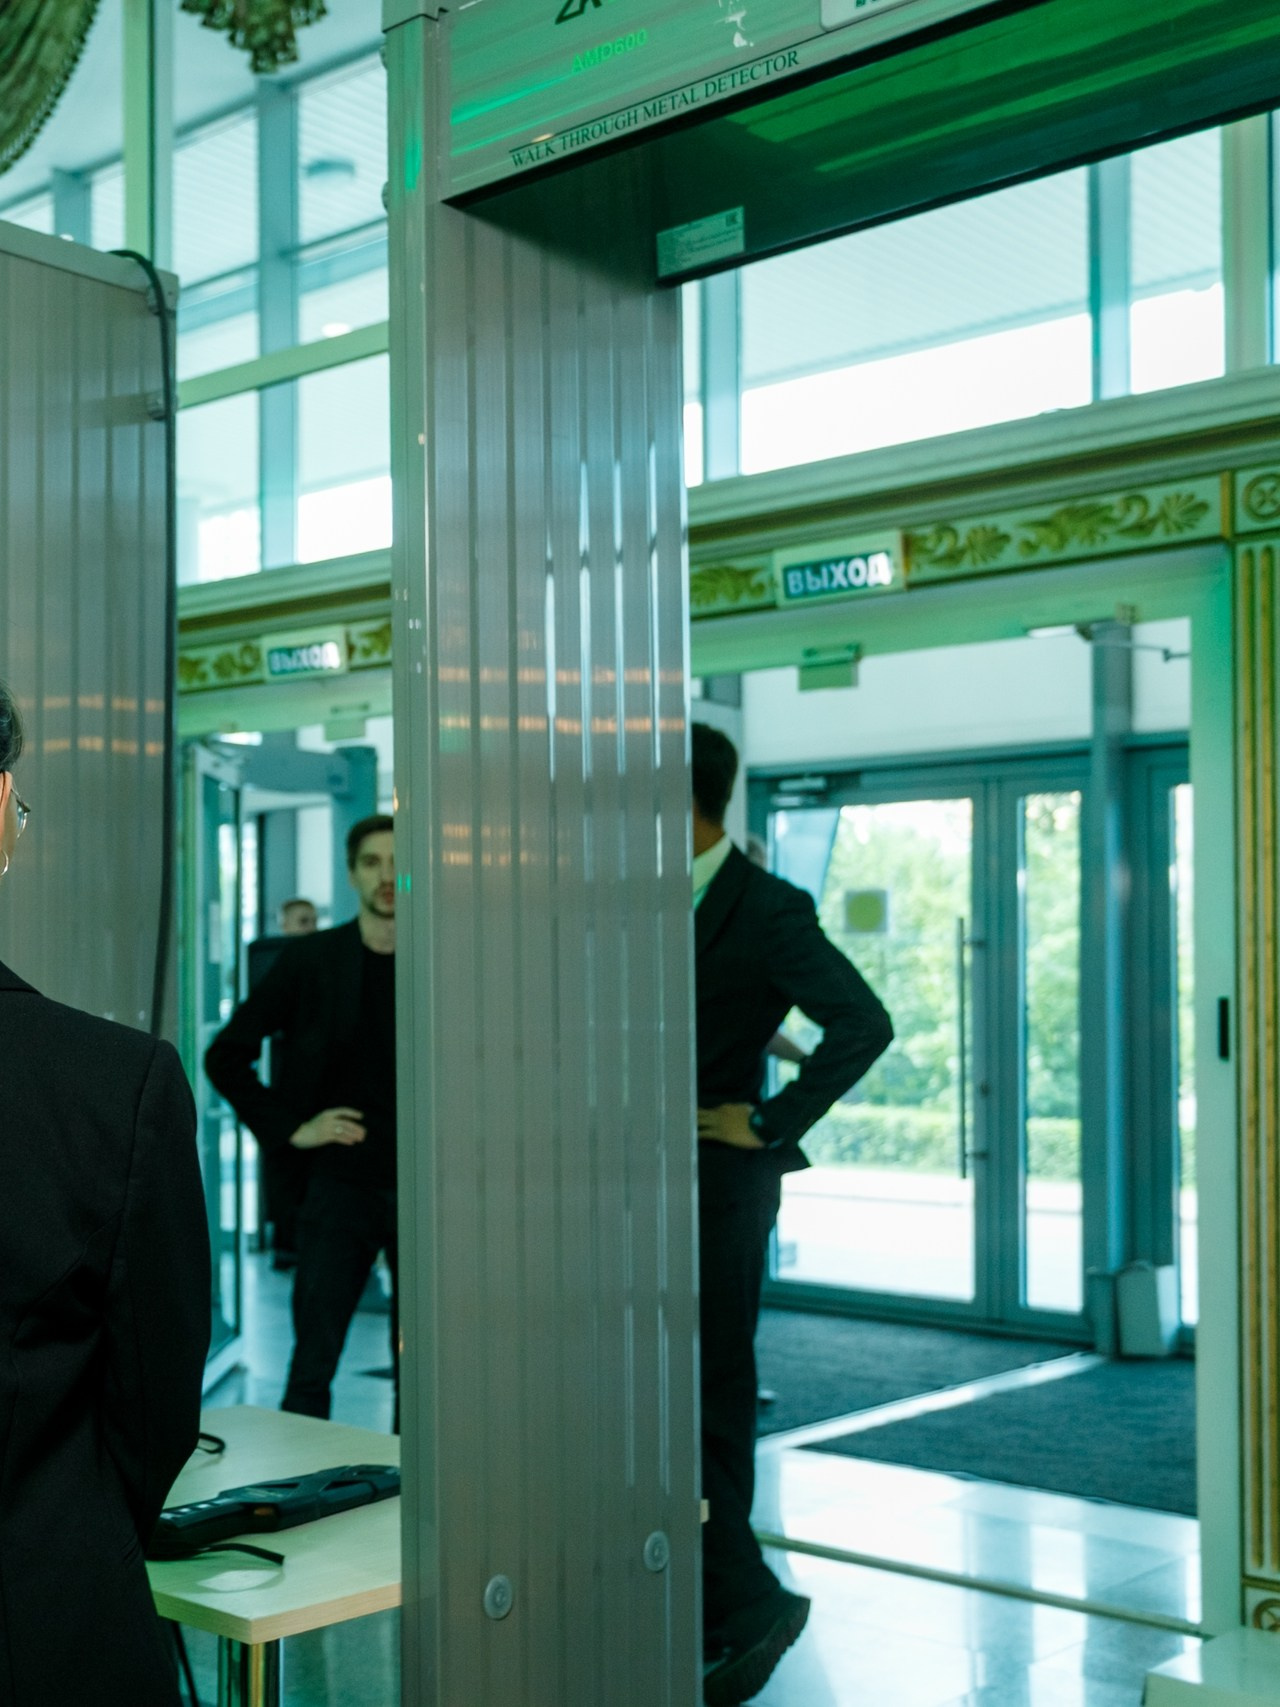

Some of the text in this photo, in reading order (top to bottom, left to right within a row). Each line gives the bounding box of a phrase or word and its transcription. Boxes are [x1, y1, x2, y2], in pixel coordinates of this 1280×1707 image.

[572, 28, 647, 74] AMD600
[511, 50, 800, 167] WALK THROUGH METAL DETECTOR
[786, 551, 893, 596] ВЫХОД
